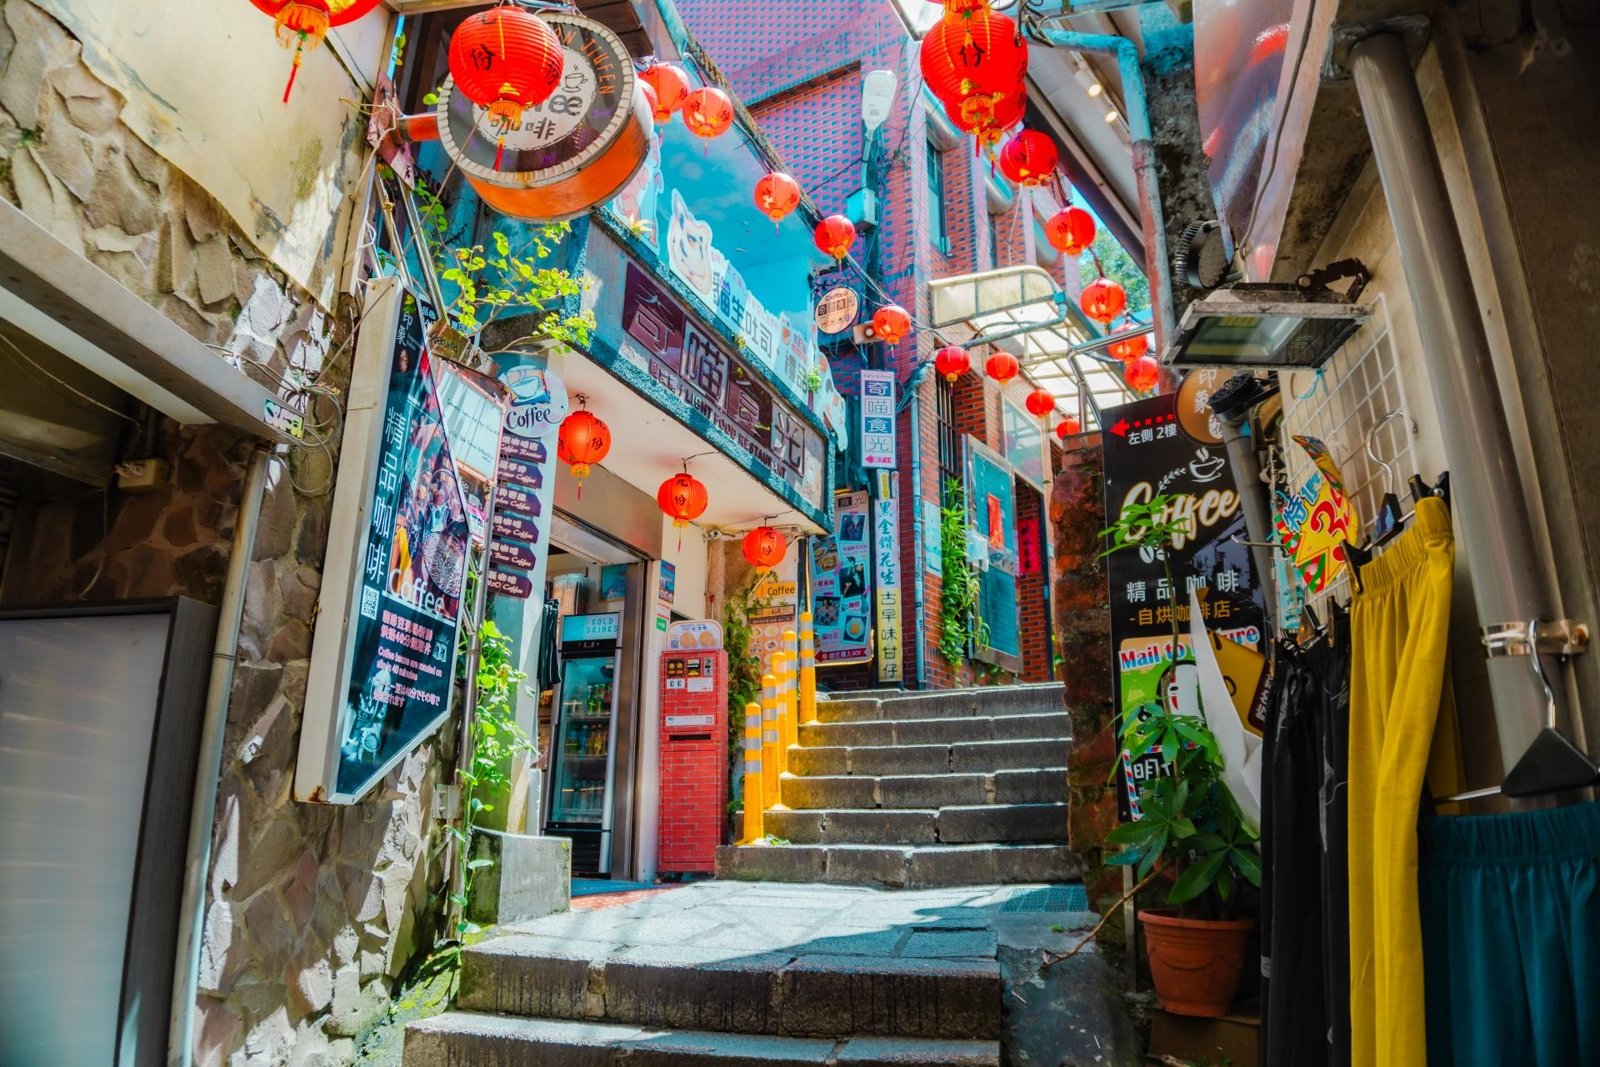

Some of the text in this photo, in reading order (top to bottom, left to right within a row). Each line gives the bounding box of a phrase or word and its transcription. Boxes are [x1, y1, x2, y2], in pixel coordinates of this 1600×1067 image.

[633, 281, 802, 468] 奇喵食光
[506, 405, 560, 429] Coffee
[866, 381, 891, 452] 奇喵食光
[1128, 423, 1178, 445] 左側 2樓
[366, 405, 407, 584] 精品咖啡
[388, 567, 446, 612] Coffee
[767, 585, 795, 596] Coffee
[1126, 569, 1240, 603] 精品咖啡
[880, 591, 898, 679] 古早味甘仔
[1120, 646, 1160, 669] Mail
[1165, 643, 1187, 660] to
